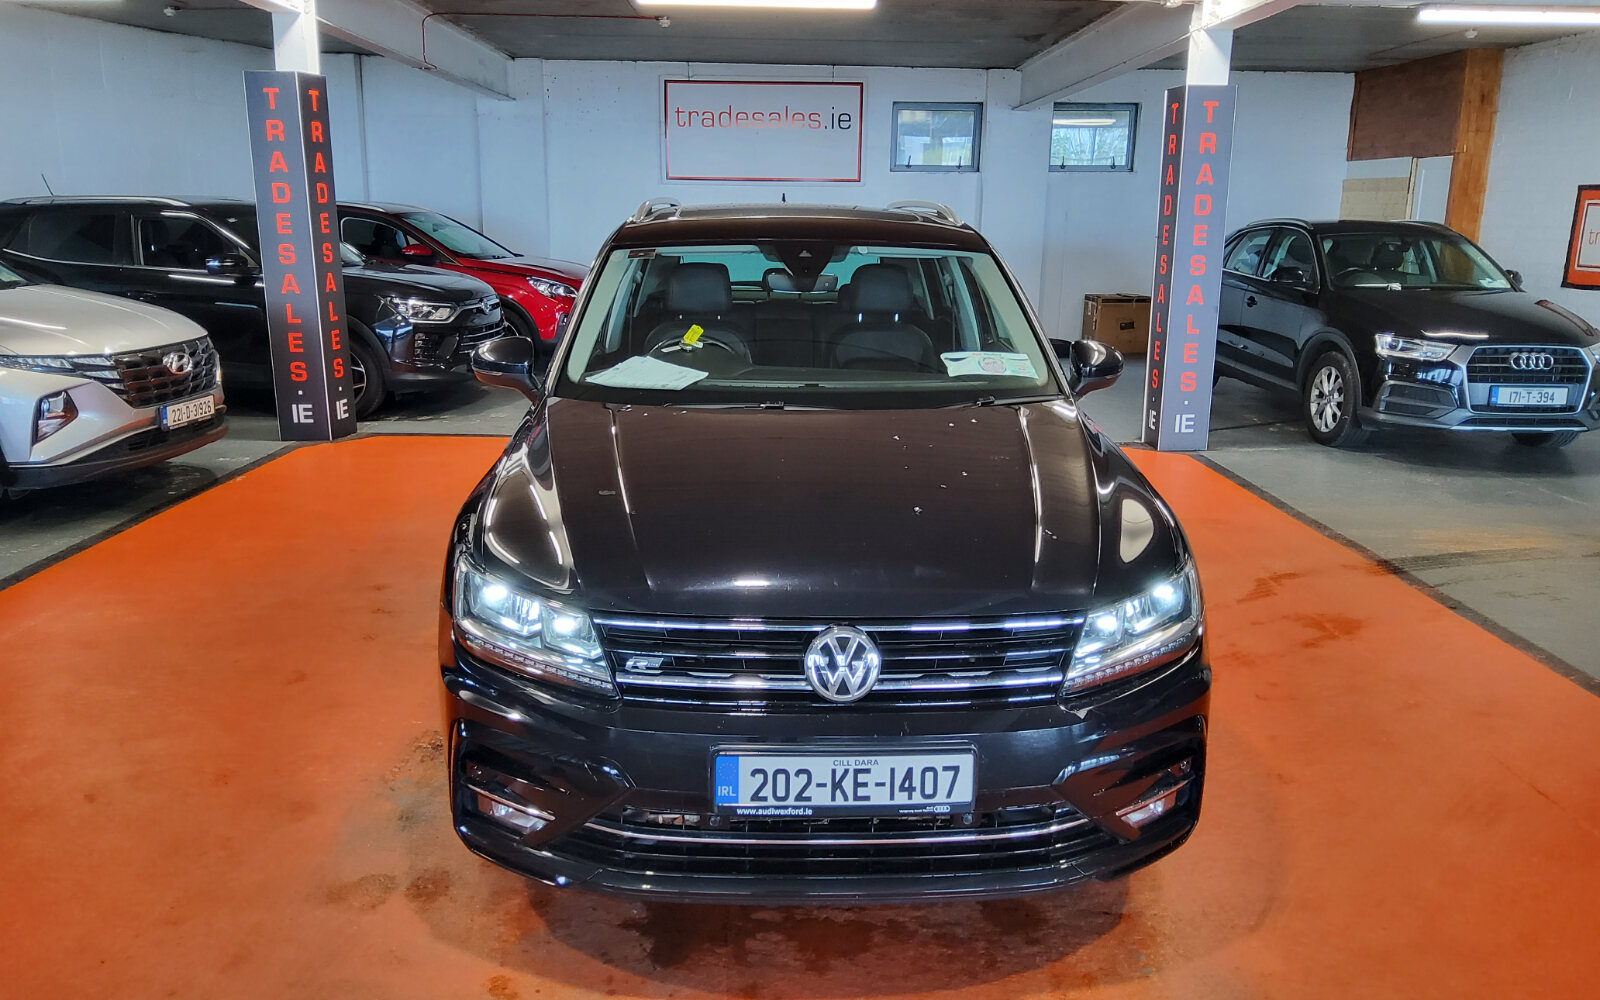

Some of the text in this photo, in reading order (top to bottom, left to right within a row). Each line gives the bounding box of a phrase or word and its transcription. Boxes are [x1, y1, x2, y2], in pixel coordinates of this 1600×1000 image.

[675, 104, 852, 130] tradesales.ie
[1508, 391, 1555, 404] 171-T-394
[832, 759, 879, 767] CILL DARA
[749, 765, 961, 803] 202-KE-1407
[717, 787, 736, 797] IRL
[736, 807, 813, 816] www.audiwexford.ie
